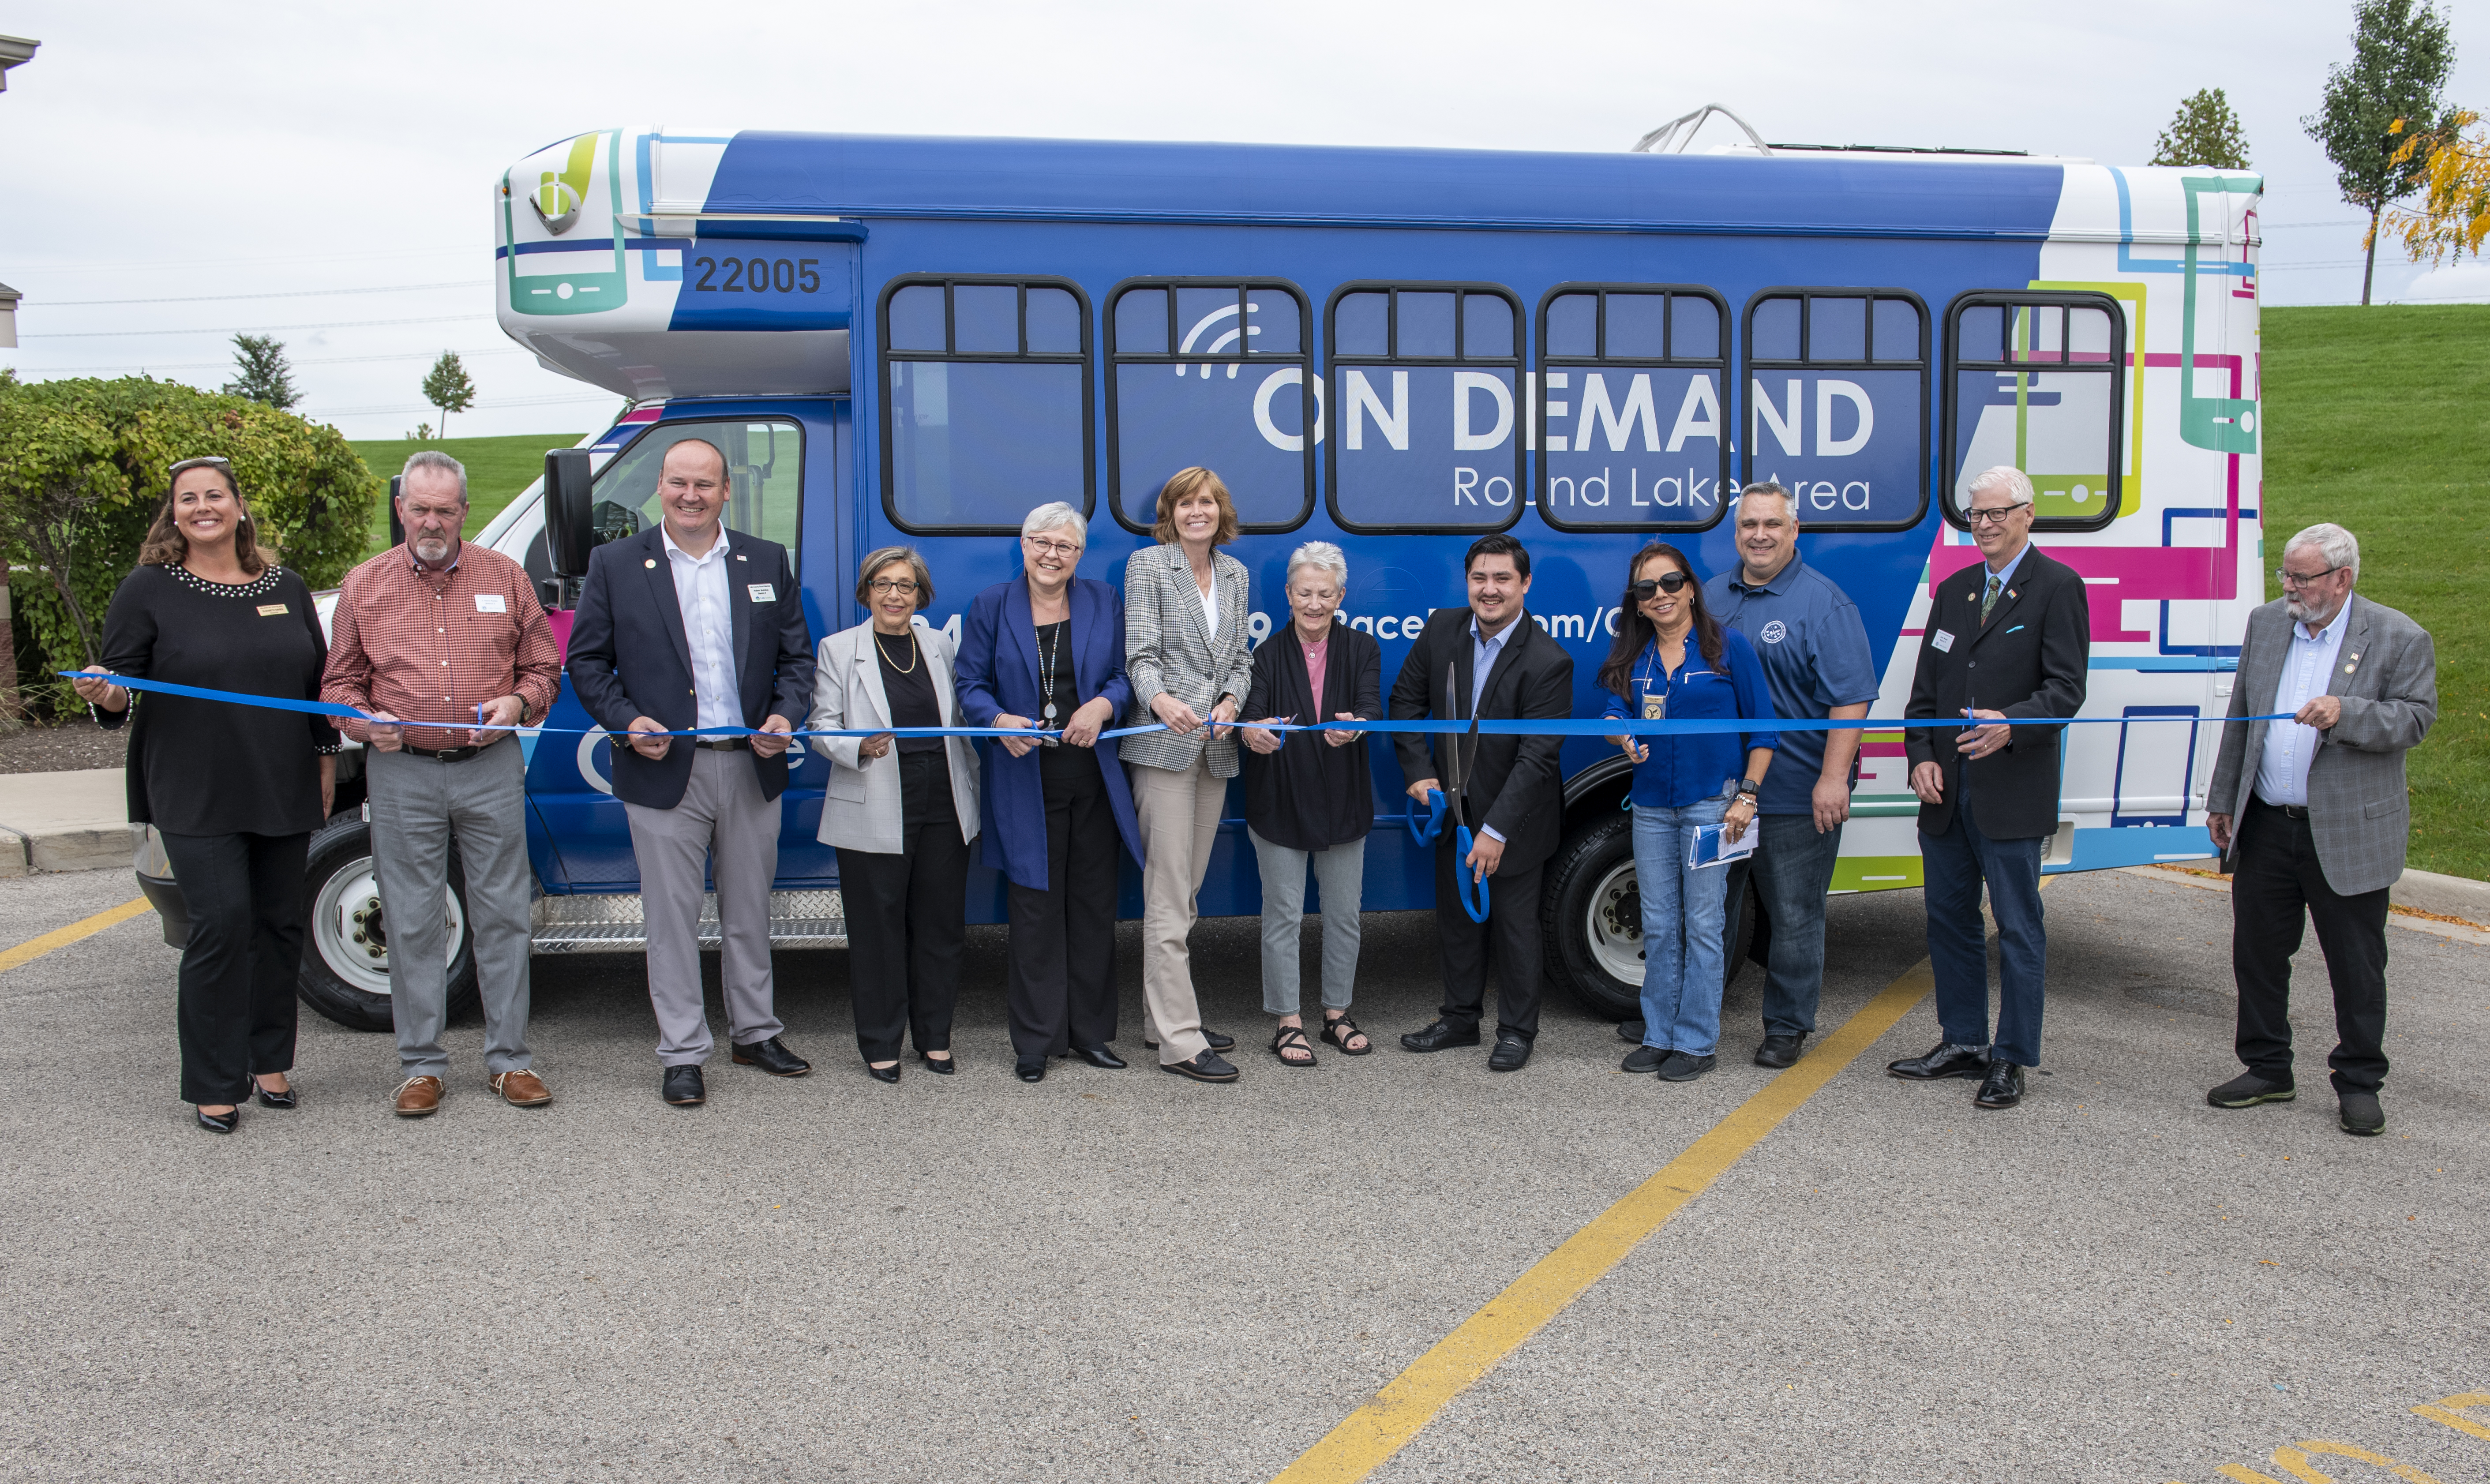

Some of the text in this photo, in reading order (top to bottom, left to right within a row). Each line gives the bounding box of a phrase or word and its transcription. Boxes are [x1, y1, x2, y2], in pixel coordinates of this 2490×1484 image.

[695, 256, 820, 293] 22005
[1253, 367, 1874, 456] ON DEMAND
[1455, 467, 1609, 506] Rond
[1631, 468, 1740, 506] Lake
